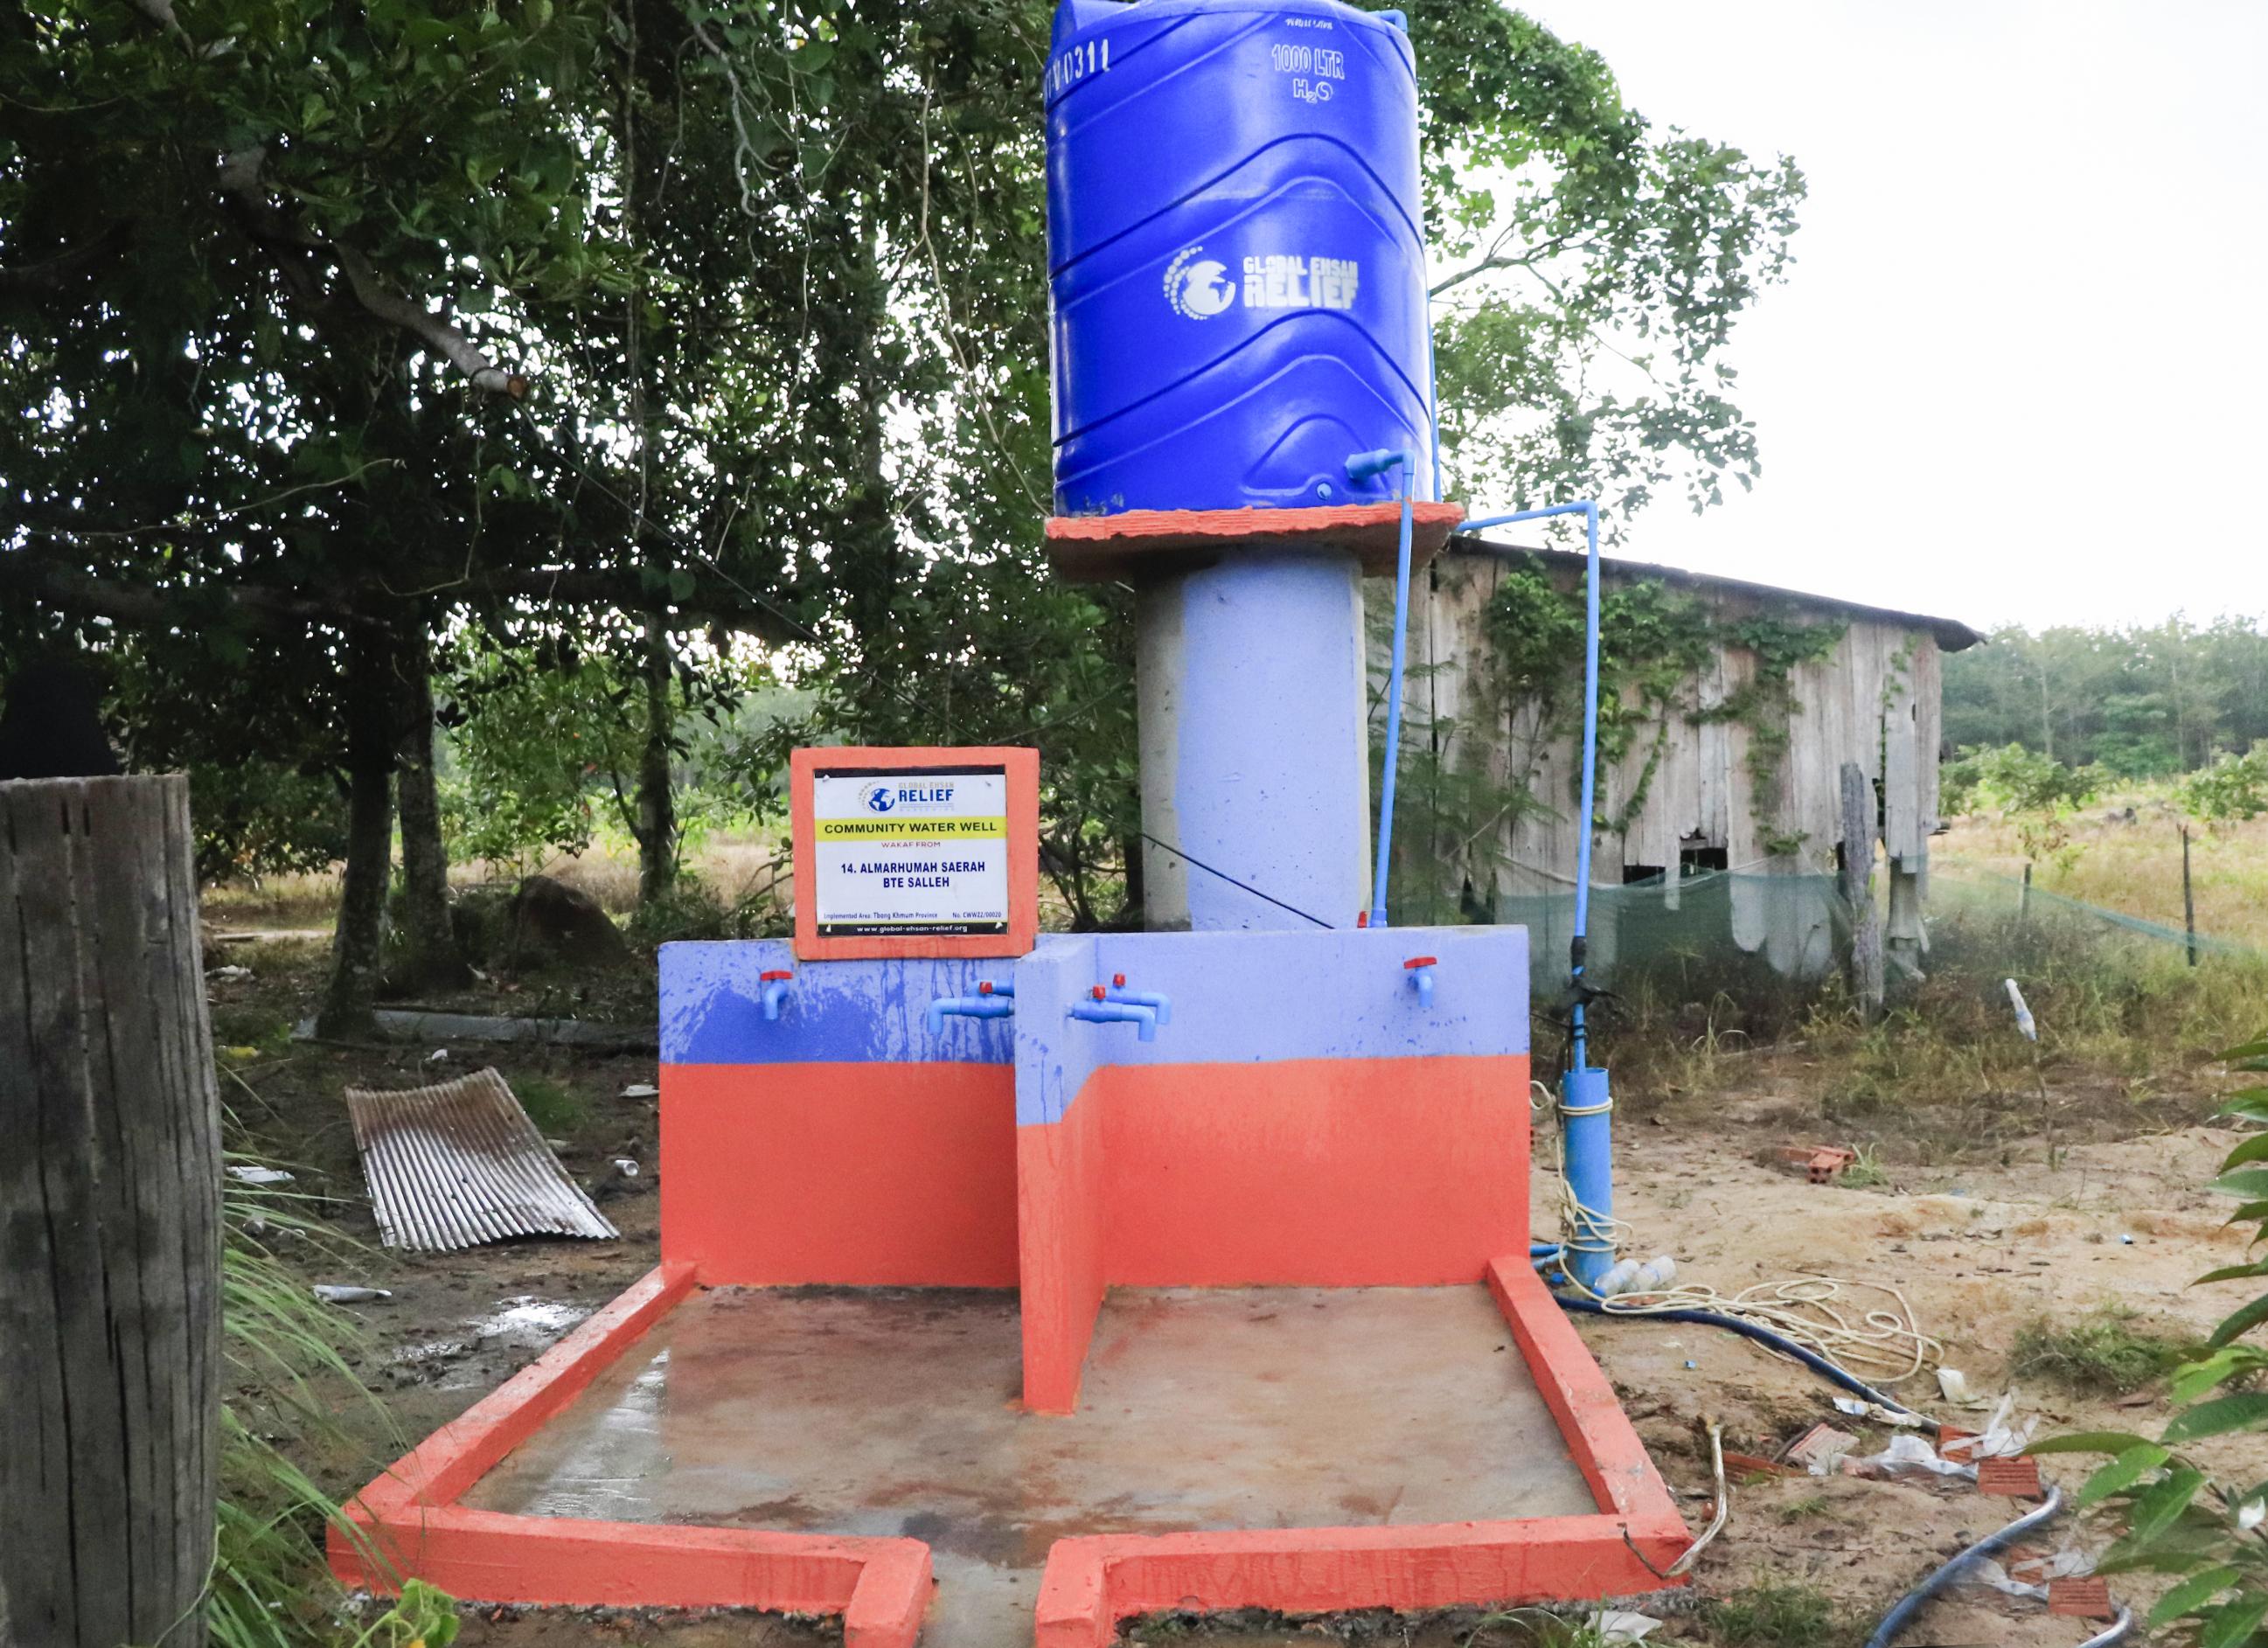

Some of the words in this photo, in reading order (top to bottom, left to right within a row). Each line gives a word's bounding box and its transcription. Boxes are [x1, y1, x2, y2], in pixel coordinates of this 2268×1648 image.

[1271, 44, 1311, 73] 1000
[1314, 48, 1346, 80] LTR
[1242, 254, 1308, 276] GLOBAL
[1310, 256, 1359, 279] EHSAN
[1243, 274, 1359, 309] RELIEF
[899, 789, 954, 802] RELIEF
[824, 823, 906, 834] COMMUNITY
[909, 823, 956, 832] WATER
[959, 822, 998, 831] WELL
[841, 863, 857, 873] 14.
[860, 862, 938, 873] ALMARHUMAH
[941, 861, 985, 873] SAERAH
[883, 878, 904, 888] BTE
[908, 877, 950, 888] SALLEH
